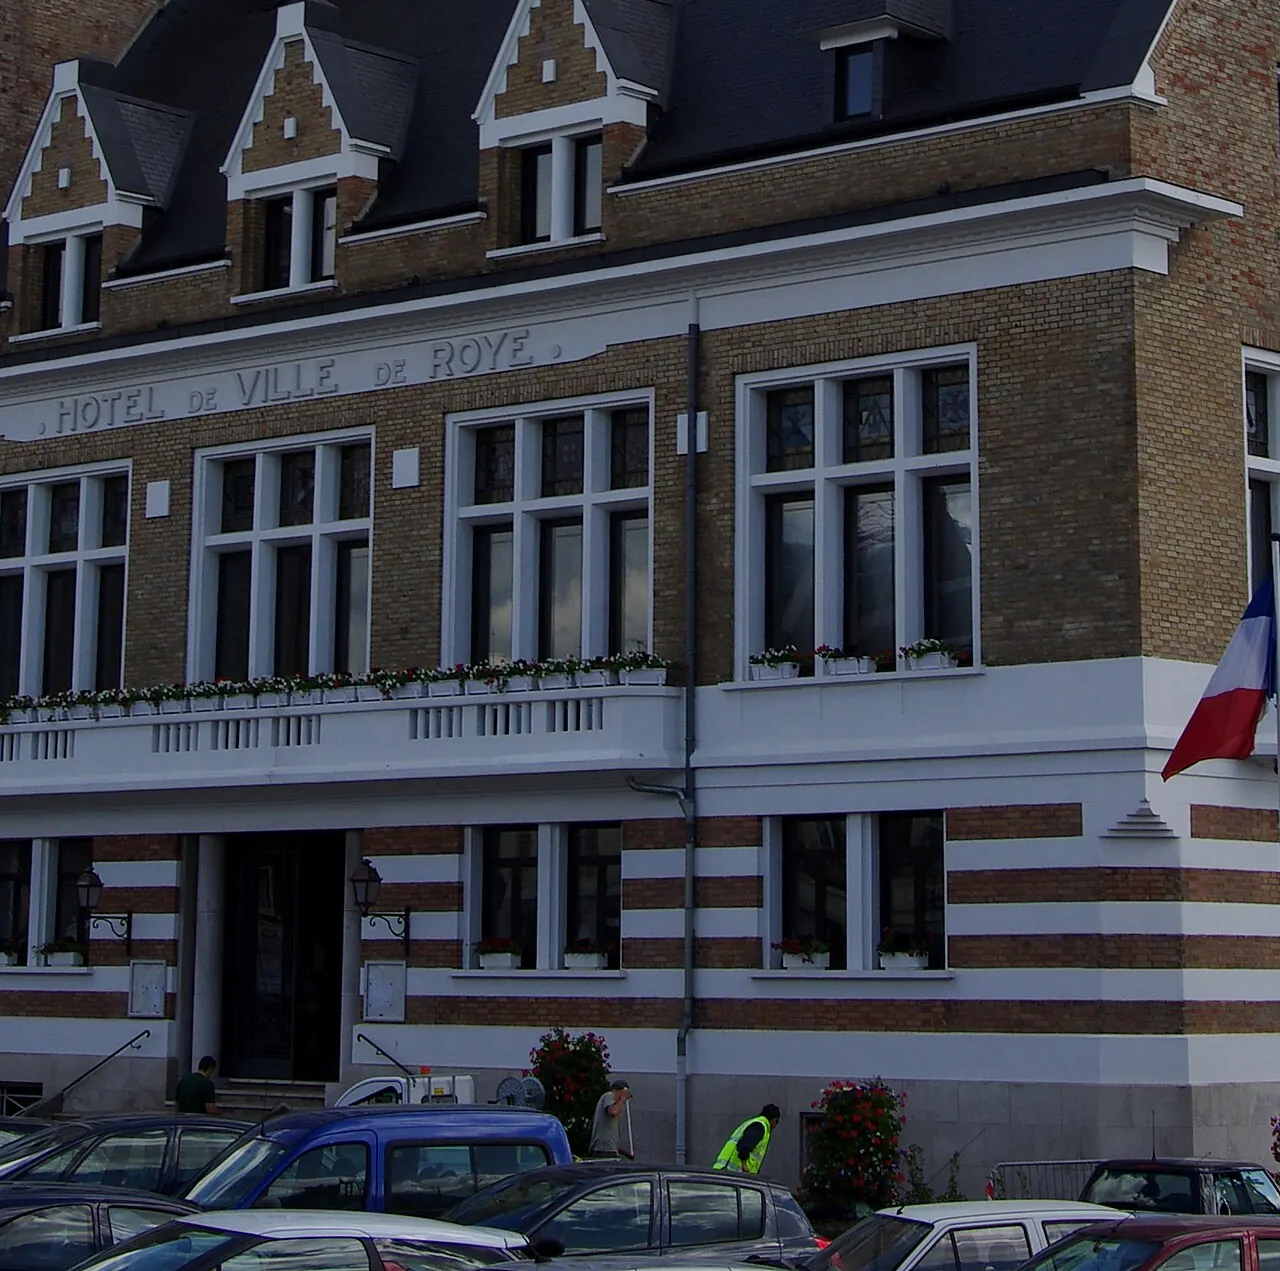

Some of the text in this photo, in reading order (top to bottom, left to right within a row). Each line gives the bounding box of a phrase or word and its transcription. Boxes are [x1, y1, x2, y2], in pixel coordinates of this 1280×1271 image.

[55, 328, 535, 434] HOTEL DE VILLE DE ROYE
